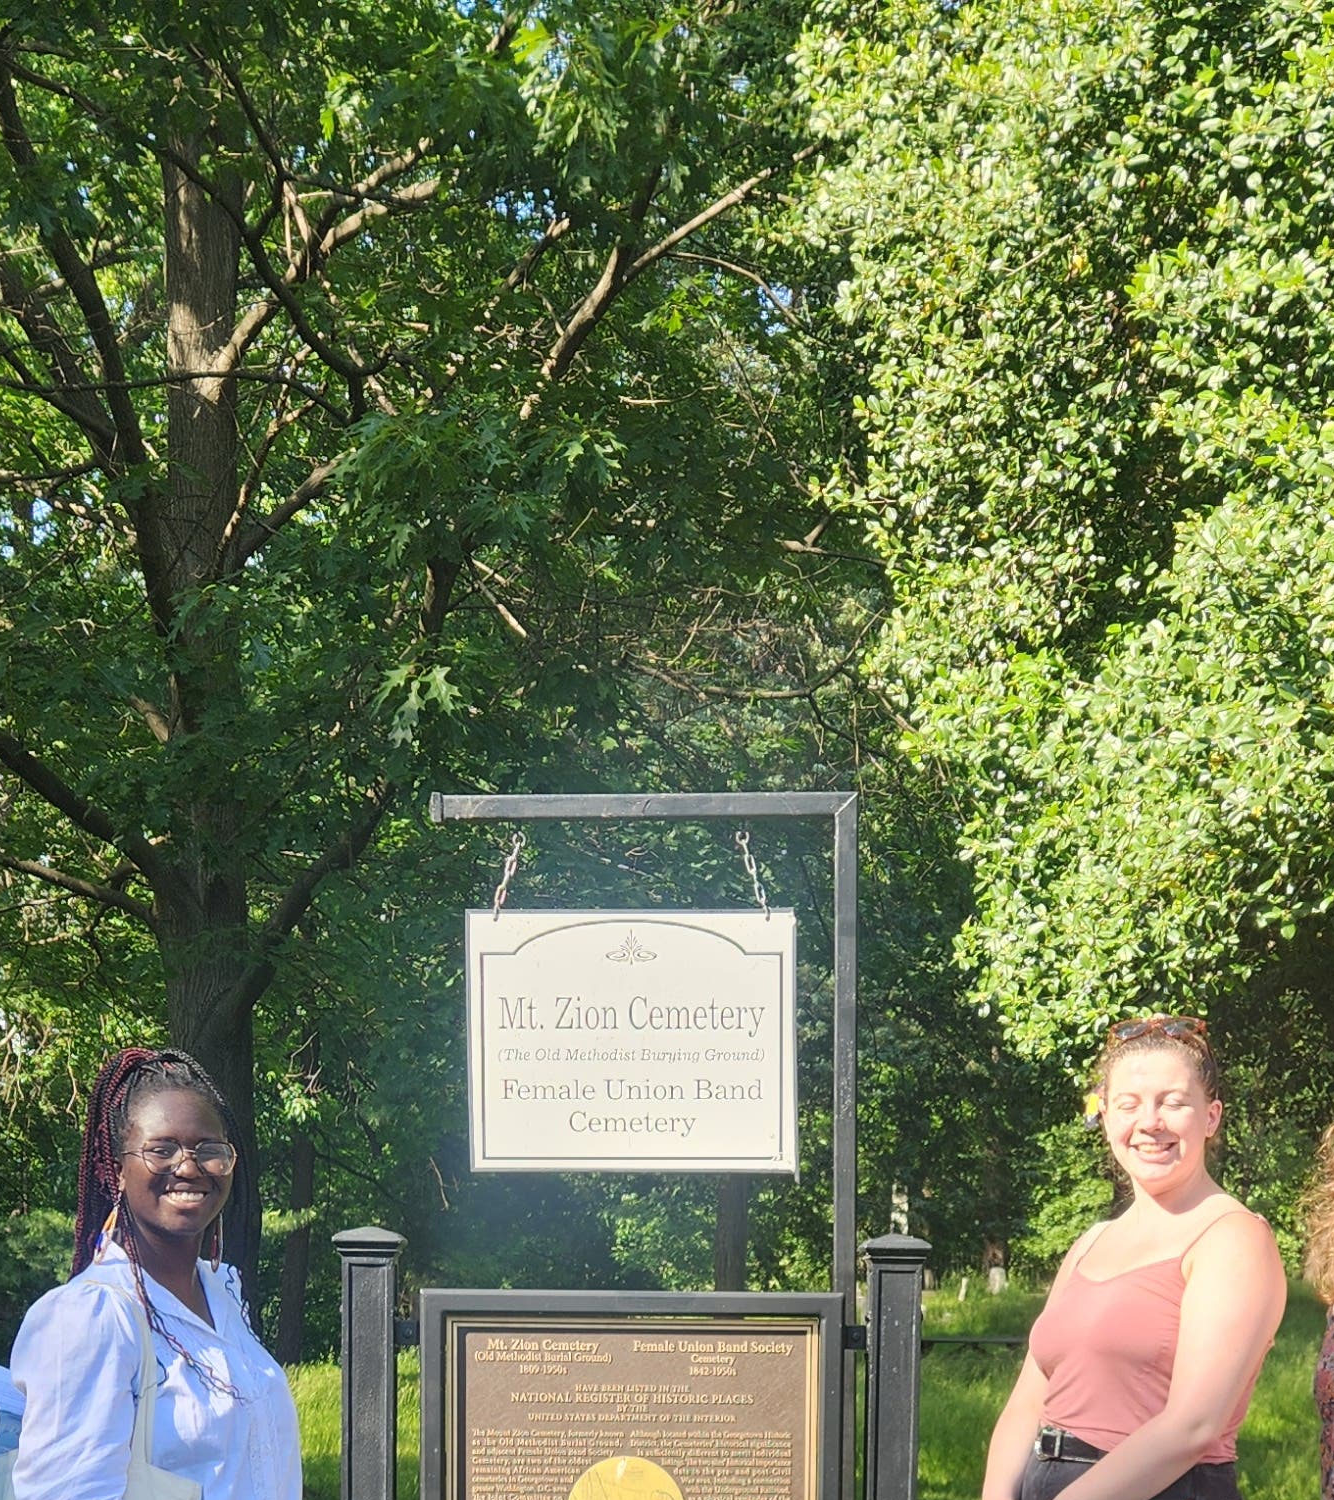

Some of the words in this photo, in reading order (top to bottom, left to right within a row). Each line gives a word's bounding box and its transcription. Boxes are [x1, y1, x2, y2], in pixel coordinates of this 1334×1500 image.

[498, 997, 544, 1029] Mt.
[555, 996, 619, 1029] Zion
[629, 996, 765, 1037] Cemetery
[498, 1049, 530, 1062] (The
[535, 1049, 561, 1061] Old
[565, 1049, 636, 1062] Methodist
[641, 1049, 700, 1064] Burying
[704, 1049, 765, 1063] Ground)
[501, 1079, 595, 1100] Female
[603, 1079, 685, 1100] Union
[693, 1079, 764, 1100] Band
[569, 1110, 697, 1137] Cemetery
[487, 1339, 508, 1351] Mt.
[511, 1339, 540, 1351] Zion
[542, 1339, 600, 1354] Cemetery
[633, 1340, 676, 1353] Female
[678, 1340, 715, 1353] Union
[717, 1341, 748, 1353] Band
[750, 1341, 793, 1356] Society
[474, 1351, 495, 1362] (Old
[497, 1351, 542, 1362] Methodist
[544, 1351, 572, 1362] Burial
[574, 1352, 613, 1364] Ground)
[690, 1354, 737, 1366] Cemetery
[575, 1384, 599, 1392] HAVE
[601, 1384, 624, 1392] BEEN
[626, 1384, 657, 1393] LISTED
[659, 1385, 670, 1393] IN
[672, 1385, 691, 1393] THE
[510, 1392, 572, 1403] NATIONAL
[575, 1392, 632, 1403] REGISTER
[634, 1393, 649, 1404] OF
[652, 1393, 709, 1404] HISTORIC
[711, 1394, 755, 1405] PLACES
[616, 1404, 628, 1413] BY
[630, 1405, 649, 1413] THE
[527, 1413, 563, 1421] UNITED
[565, 1413, 596, 1422] STATES
[598, 1414, 657, 1422] DEPARTMENT
[673, 1415, 691, 1423] THE
[693, 1415, 737, 1423] INTERIOR
